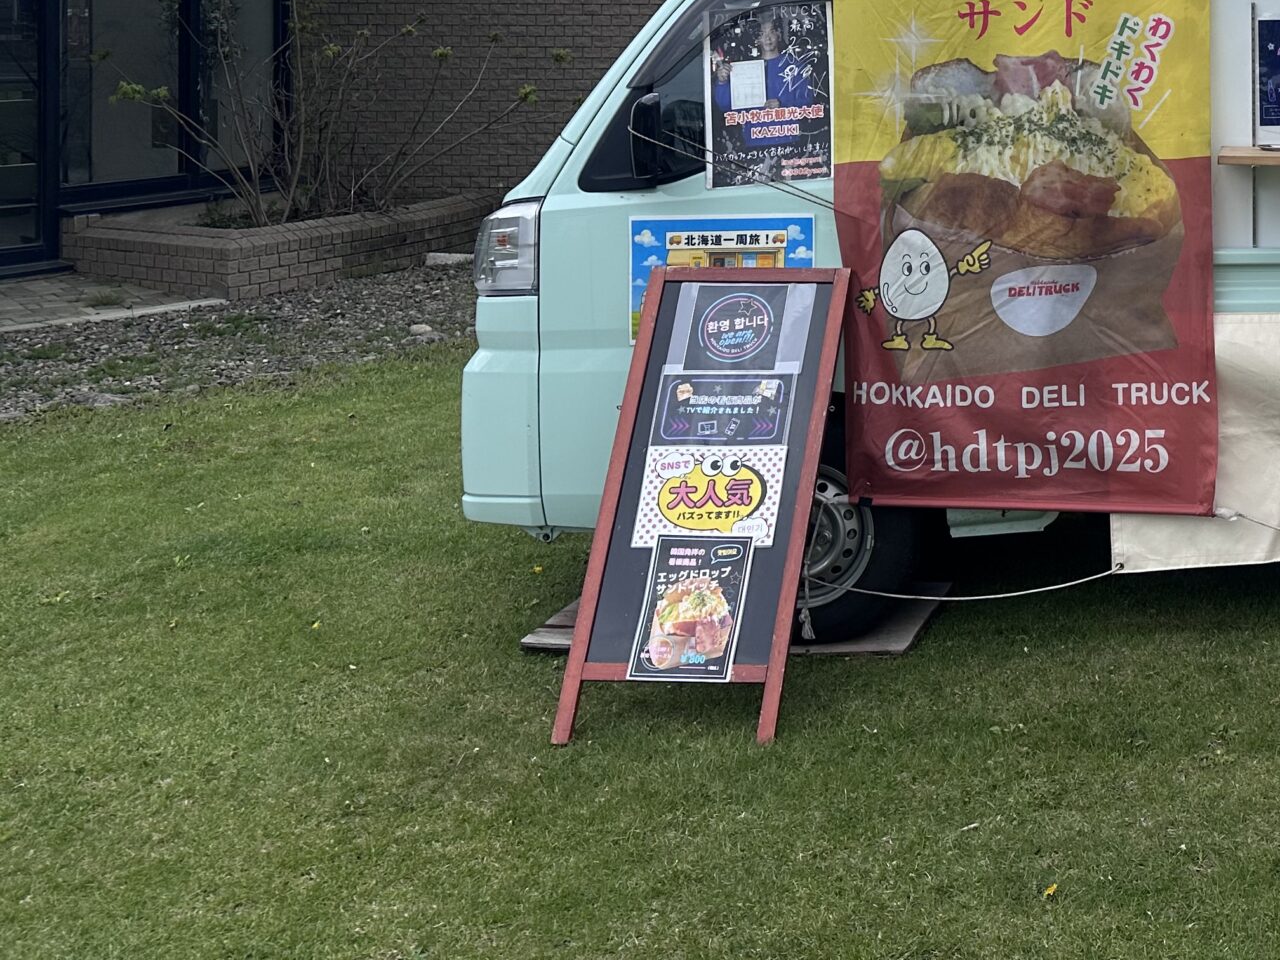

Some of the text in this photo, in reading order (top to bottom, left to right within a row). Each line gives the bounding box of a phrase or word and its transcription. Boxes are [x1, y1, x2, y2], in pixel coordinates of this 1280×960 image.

[771, 4, 821, 19] TRUCK
[1093, 16, 1140, 106] ドキドキ
[1126, 17, 1172, 108] わくわく
[724, 104, 824, 126] 苫小牧市観光大使
[751, 125, 800, 139] KAZUKI
[684, 233, 769, 246] 北海道一周旅！
[1008, 282, 1080, 298] DELI TRUCK
[707, 314, 769, 333] 환영 합니다
[853, 380, 1211, 409] HOKKAIDO DELI TRUCK
[885, 428, 1170, 479] @hdtpj2025
[660, 460, 691, 472] SNSで
[667, 479, 752, 510] 大人気
[657, 566, 732, 582] エッグドロップ
[656, 580, 719, 594] サンドイッチ
[680, 654, 706, 664] ¥800
